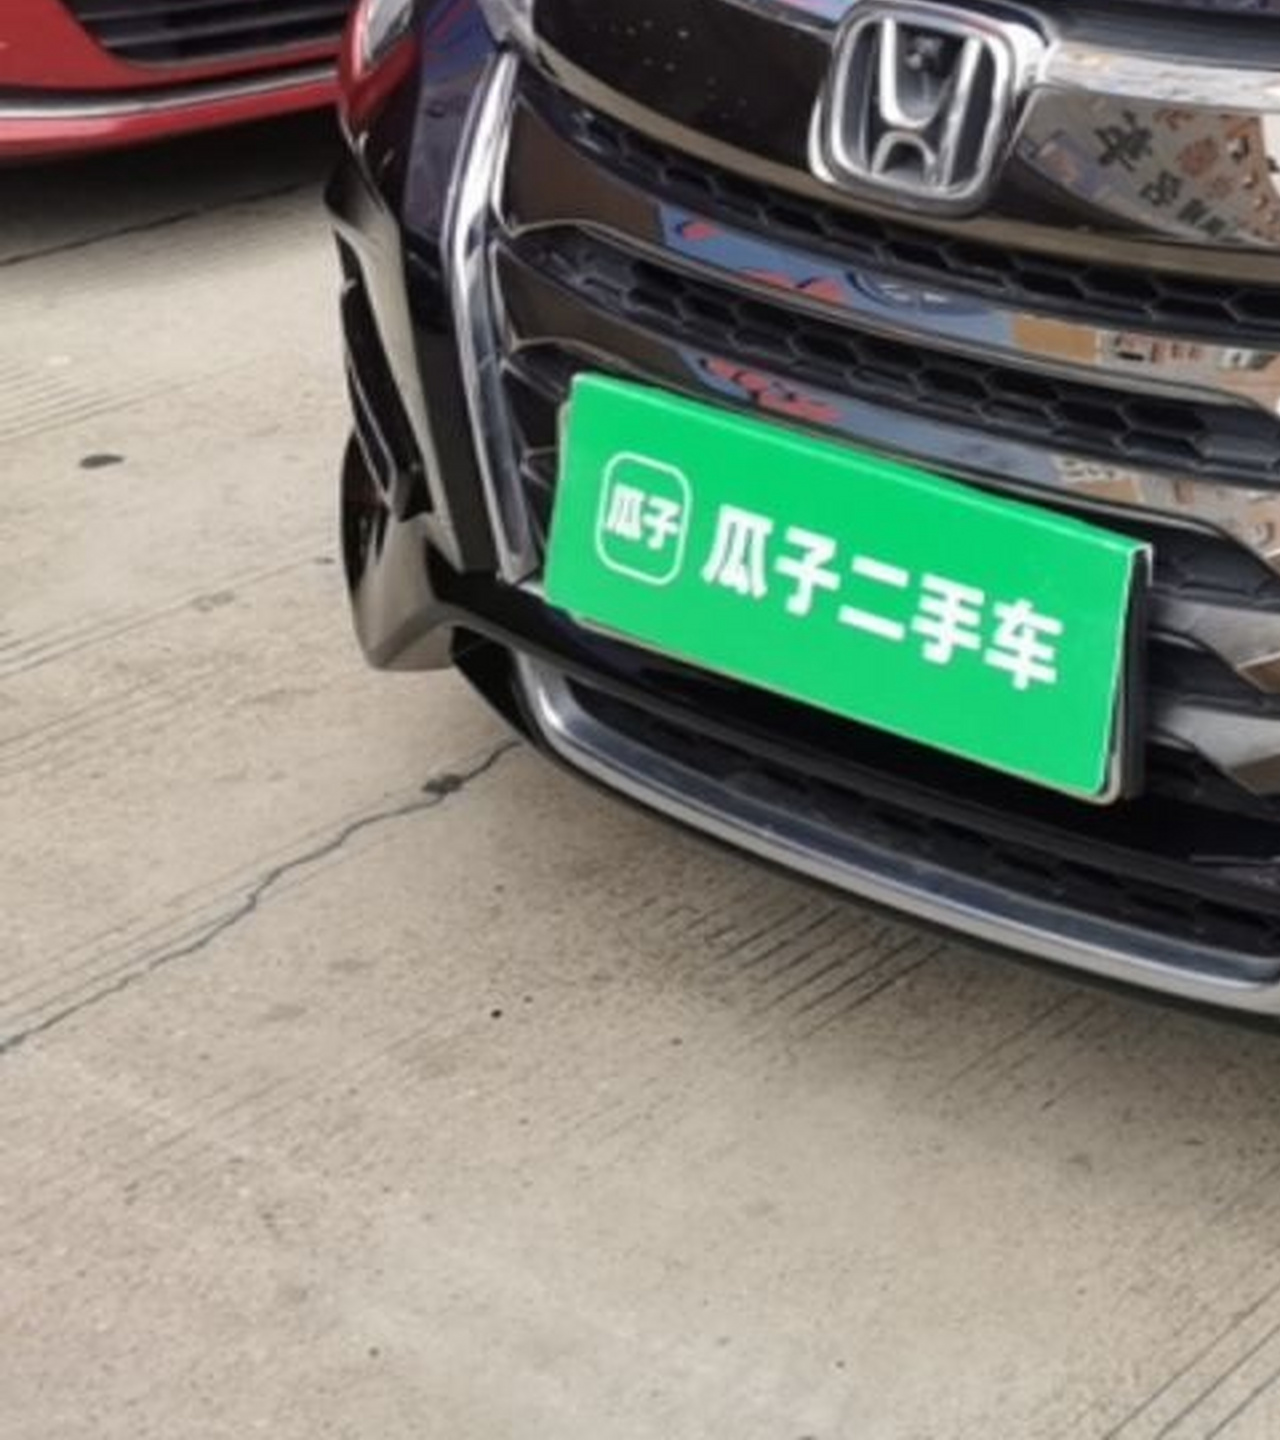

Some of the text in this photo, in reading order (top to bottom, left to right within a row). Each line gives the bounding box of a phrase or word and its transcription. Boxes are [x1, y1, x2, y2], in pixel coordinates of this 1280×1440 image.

[604, 482, 681, 551] 瓜子
[701, 503, 1064, 691] 瓜子二手车
